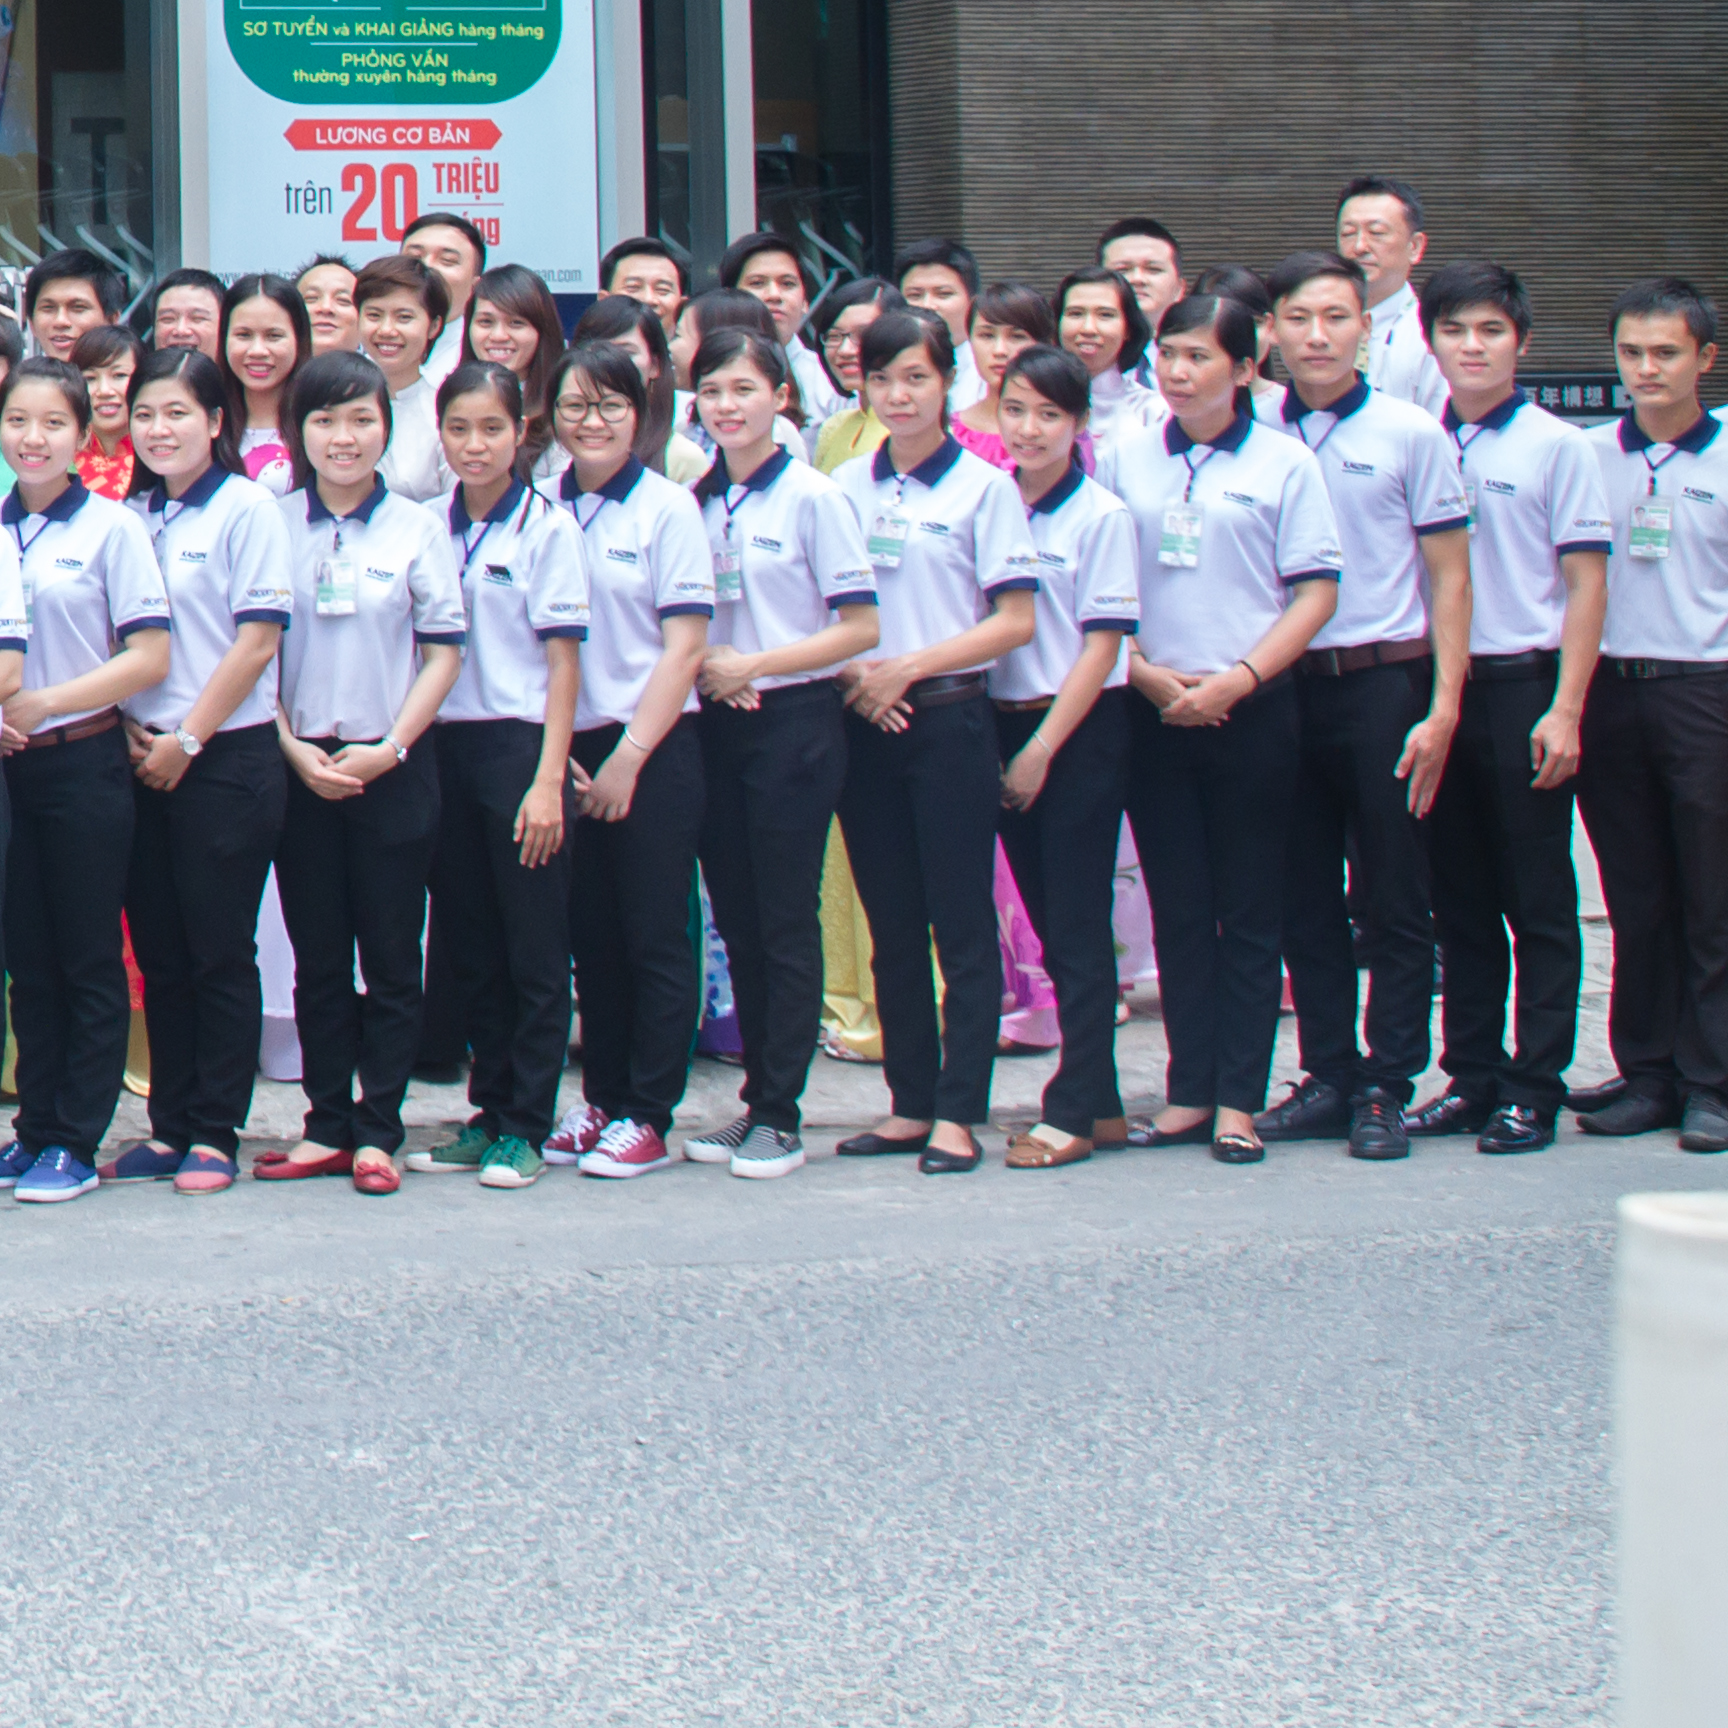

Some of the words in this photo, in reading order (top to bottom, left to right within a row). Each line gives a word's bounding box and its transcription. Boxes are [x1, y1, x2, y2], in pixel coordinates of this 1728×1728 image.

[243, 21, 268, 37] SƠ
[274, 15, 328, 36] TUYỂN
[333, 23, 350, 37] và
[355, 22, 395, 36] KHAI
[400, 18, 455, 37] GIẢNG
[459, 22, 497, 40] hàng
[501, 23, 545, 40] tháng
[342, 49, 406, 67] PHỎNG
[411, 48, 449, 68] VẤN
[355, 70, 402, 86] xuyên
[407, 69, 446, 86] hàng
[451, 69, 498, 86] tháng
[316, 126, 387, 145] LƯƠNG
[393, 127, 422, 145] CƠ
[429, 123, 470, 145] BẢN
[432, 156, 500, 201] TRIỆU
[285, 180, 332, 215] trên
[341, 162, 419, 243] 20
